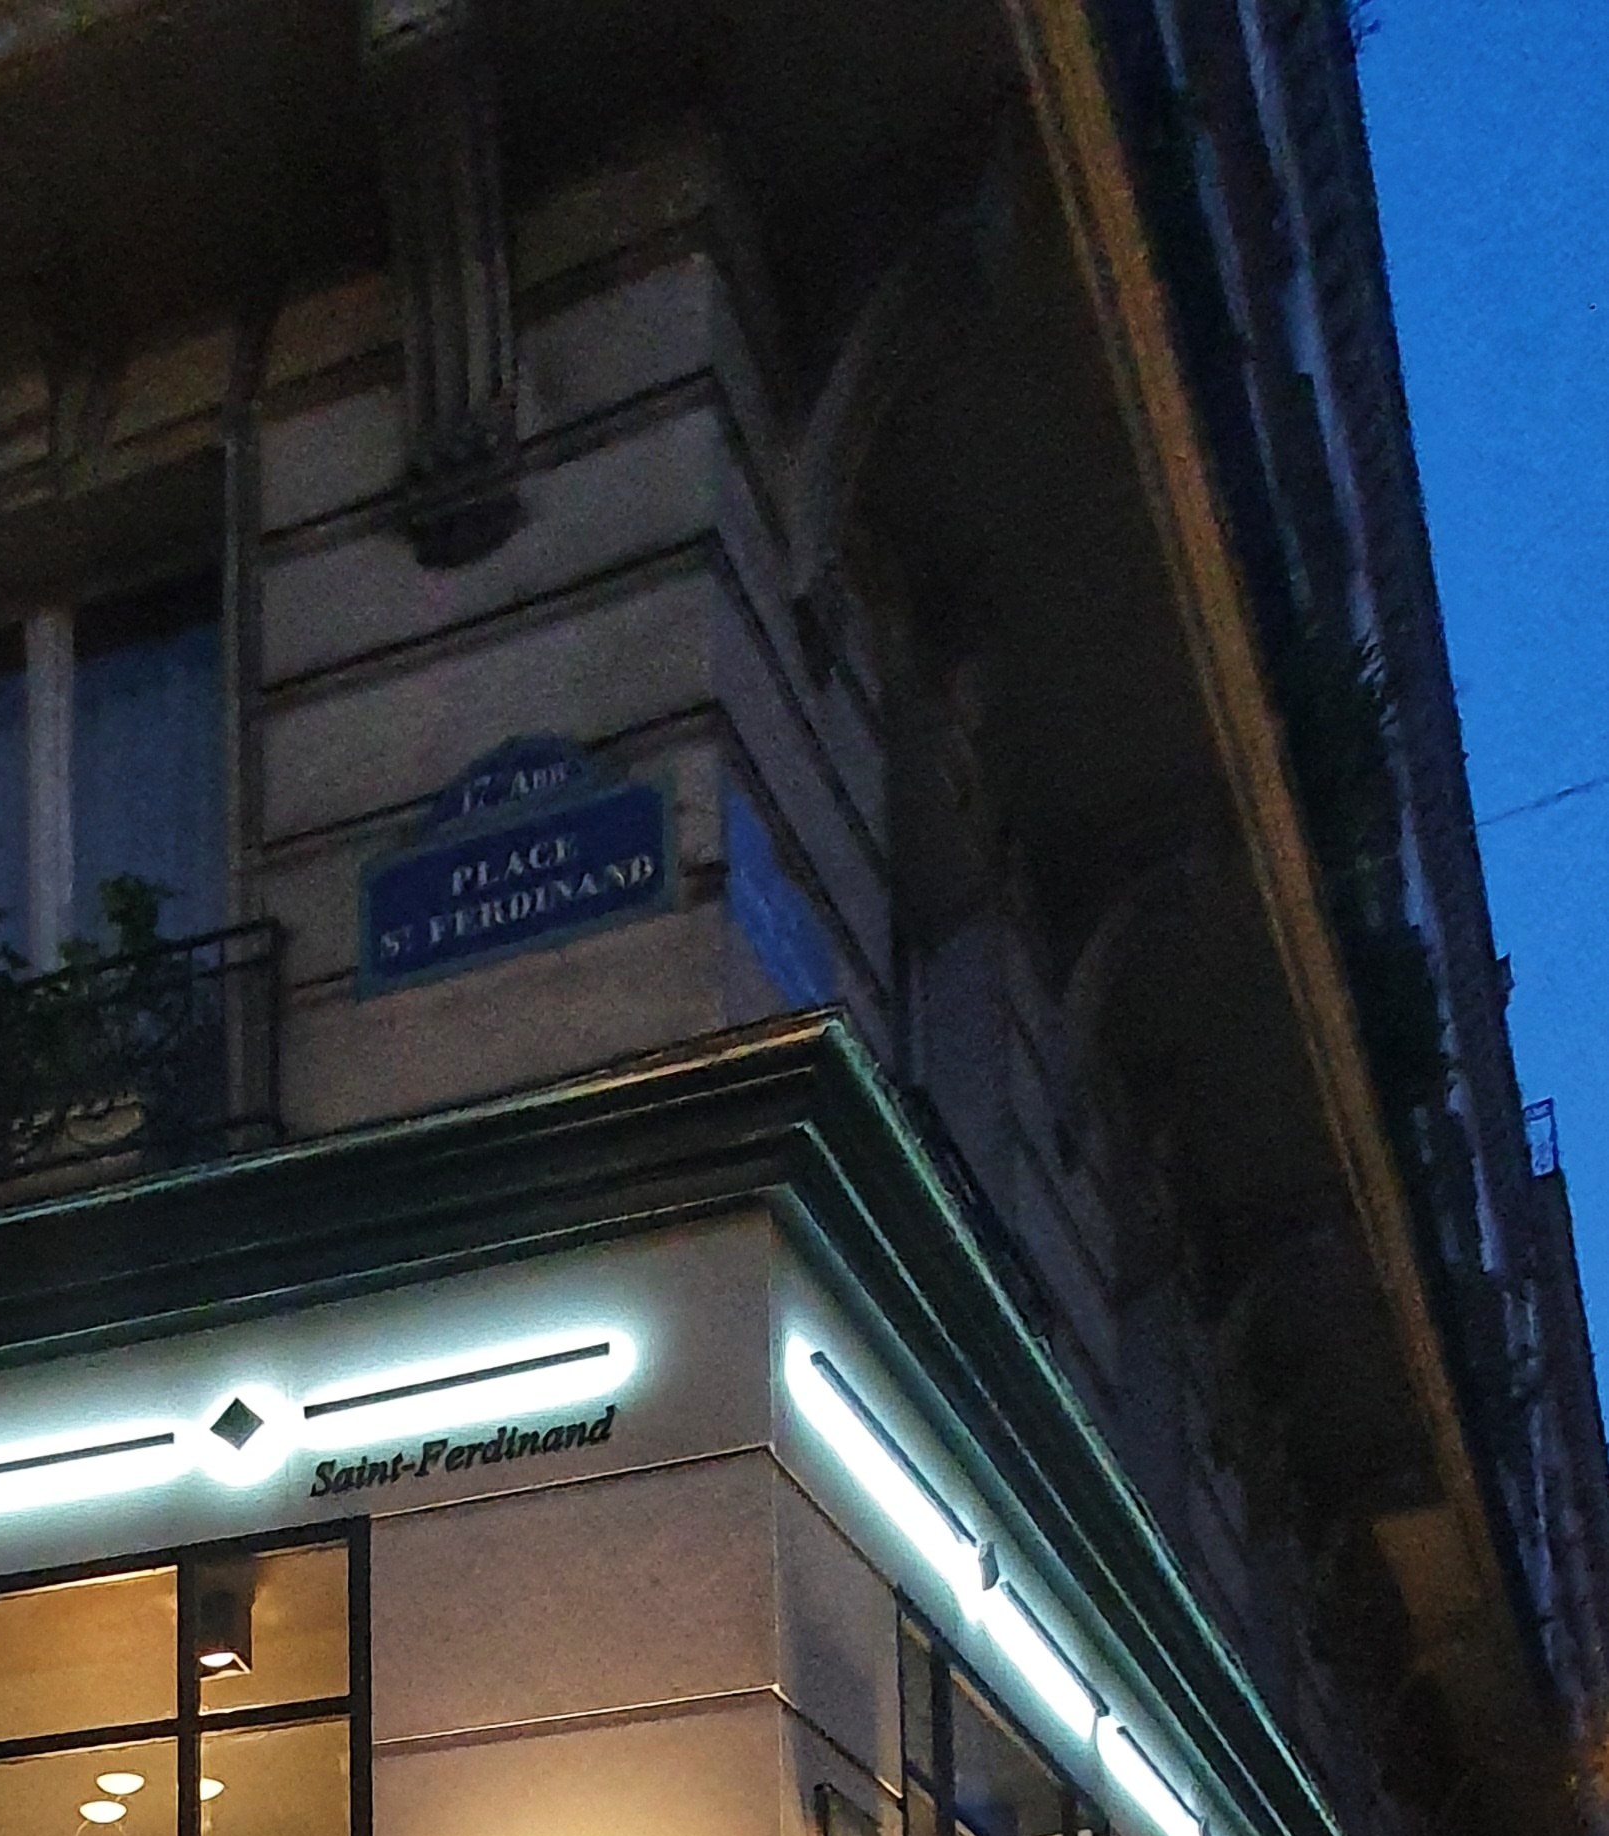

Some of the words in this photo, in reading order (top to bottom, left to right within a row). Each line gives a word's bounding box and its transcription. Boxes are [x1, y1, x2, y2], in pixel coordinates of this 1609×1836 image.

[428, 853, 656, 946] FERDINAND
[451, 833, 578, 898] PLACE
[310, 1403, 616, 1498] Saint-Ferdinand
